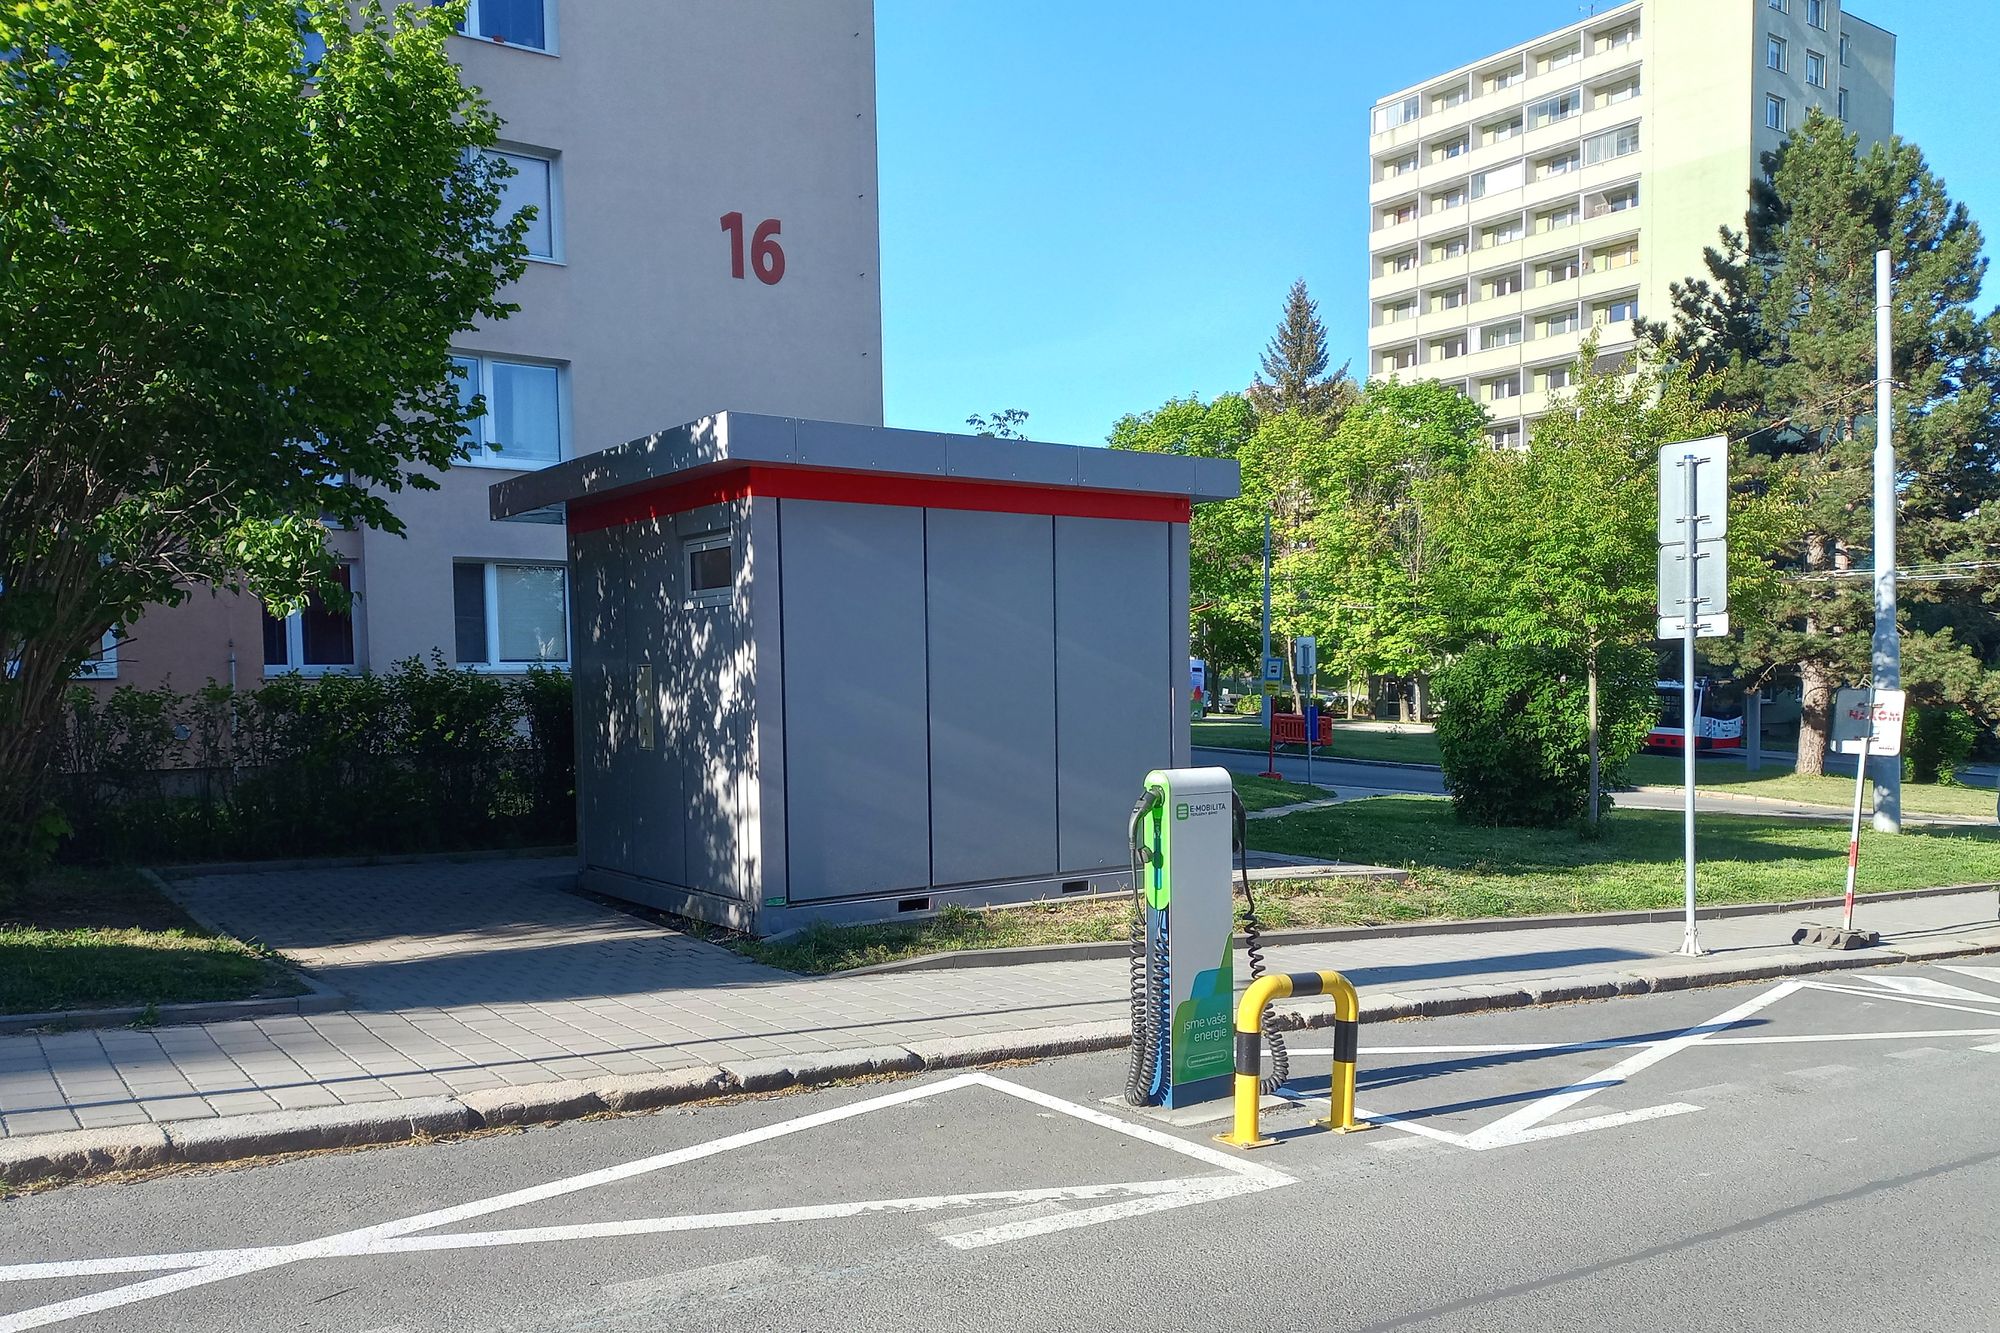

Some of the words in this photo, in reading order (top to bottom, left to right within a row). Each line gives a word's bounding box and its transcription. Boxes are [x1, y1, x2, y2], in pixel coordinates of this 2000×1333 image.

[720, 211, 786, 286] 16
[1190, 803, 1226, 812] E-MOBILITA
[1183, 1018, 1205, 1034] jsme
[1206, 1011, 1227, 1026] vaše
[1194, 1027, 1227, 1042] energie
